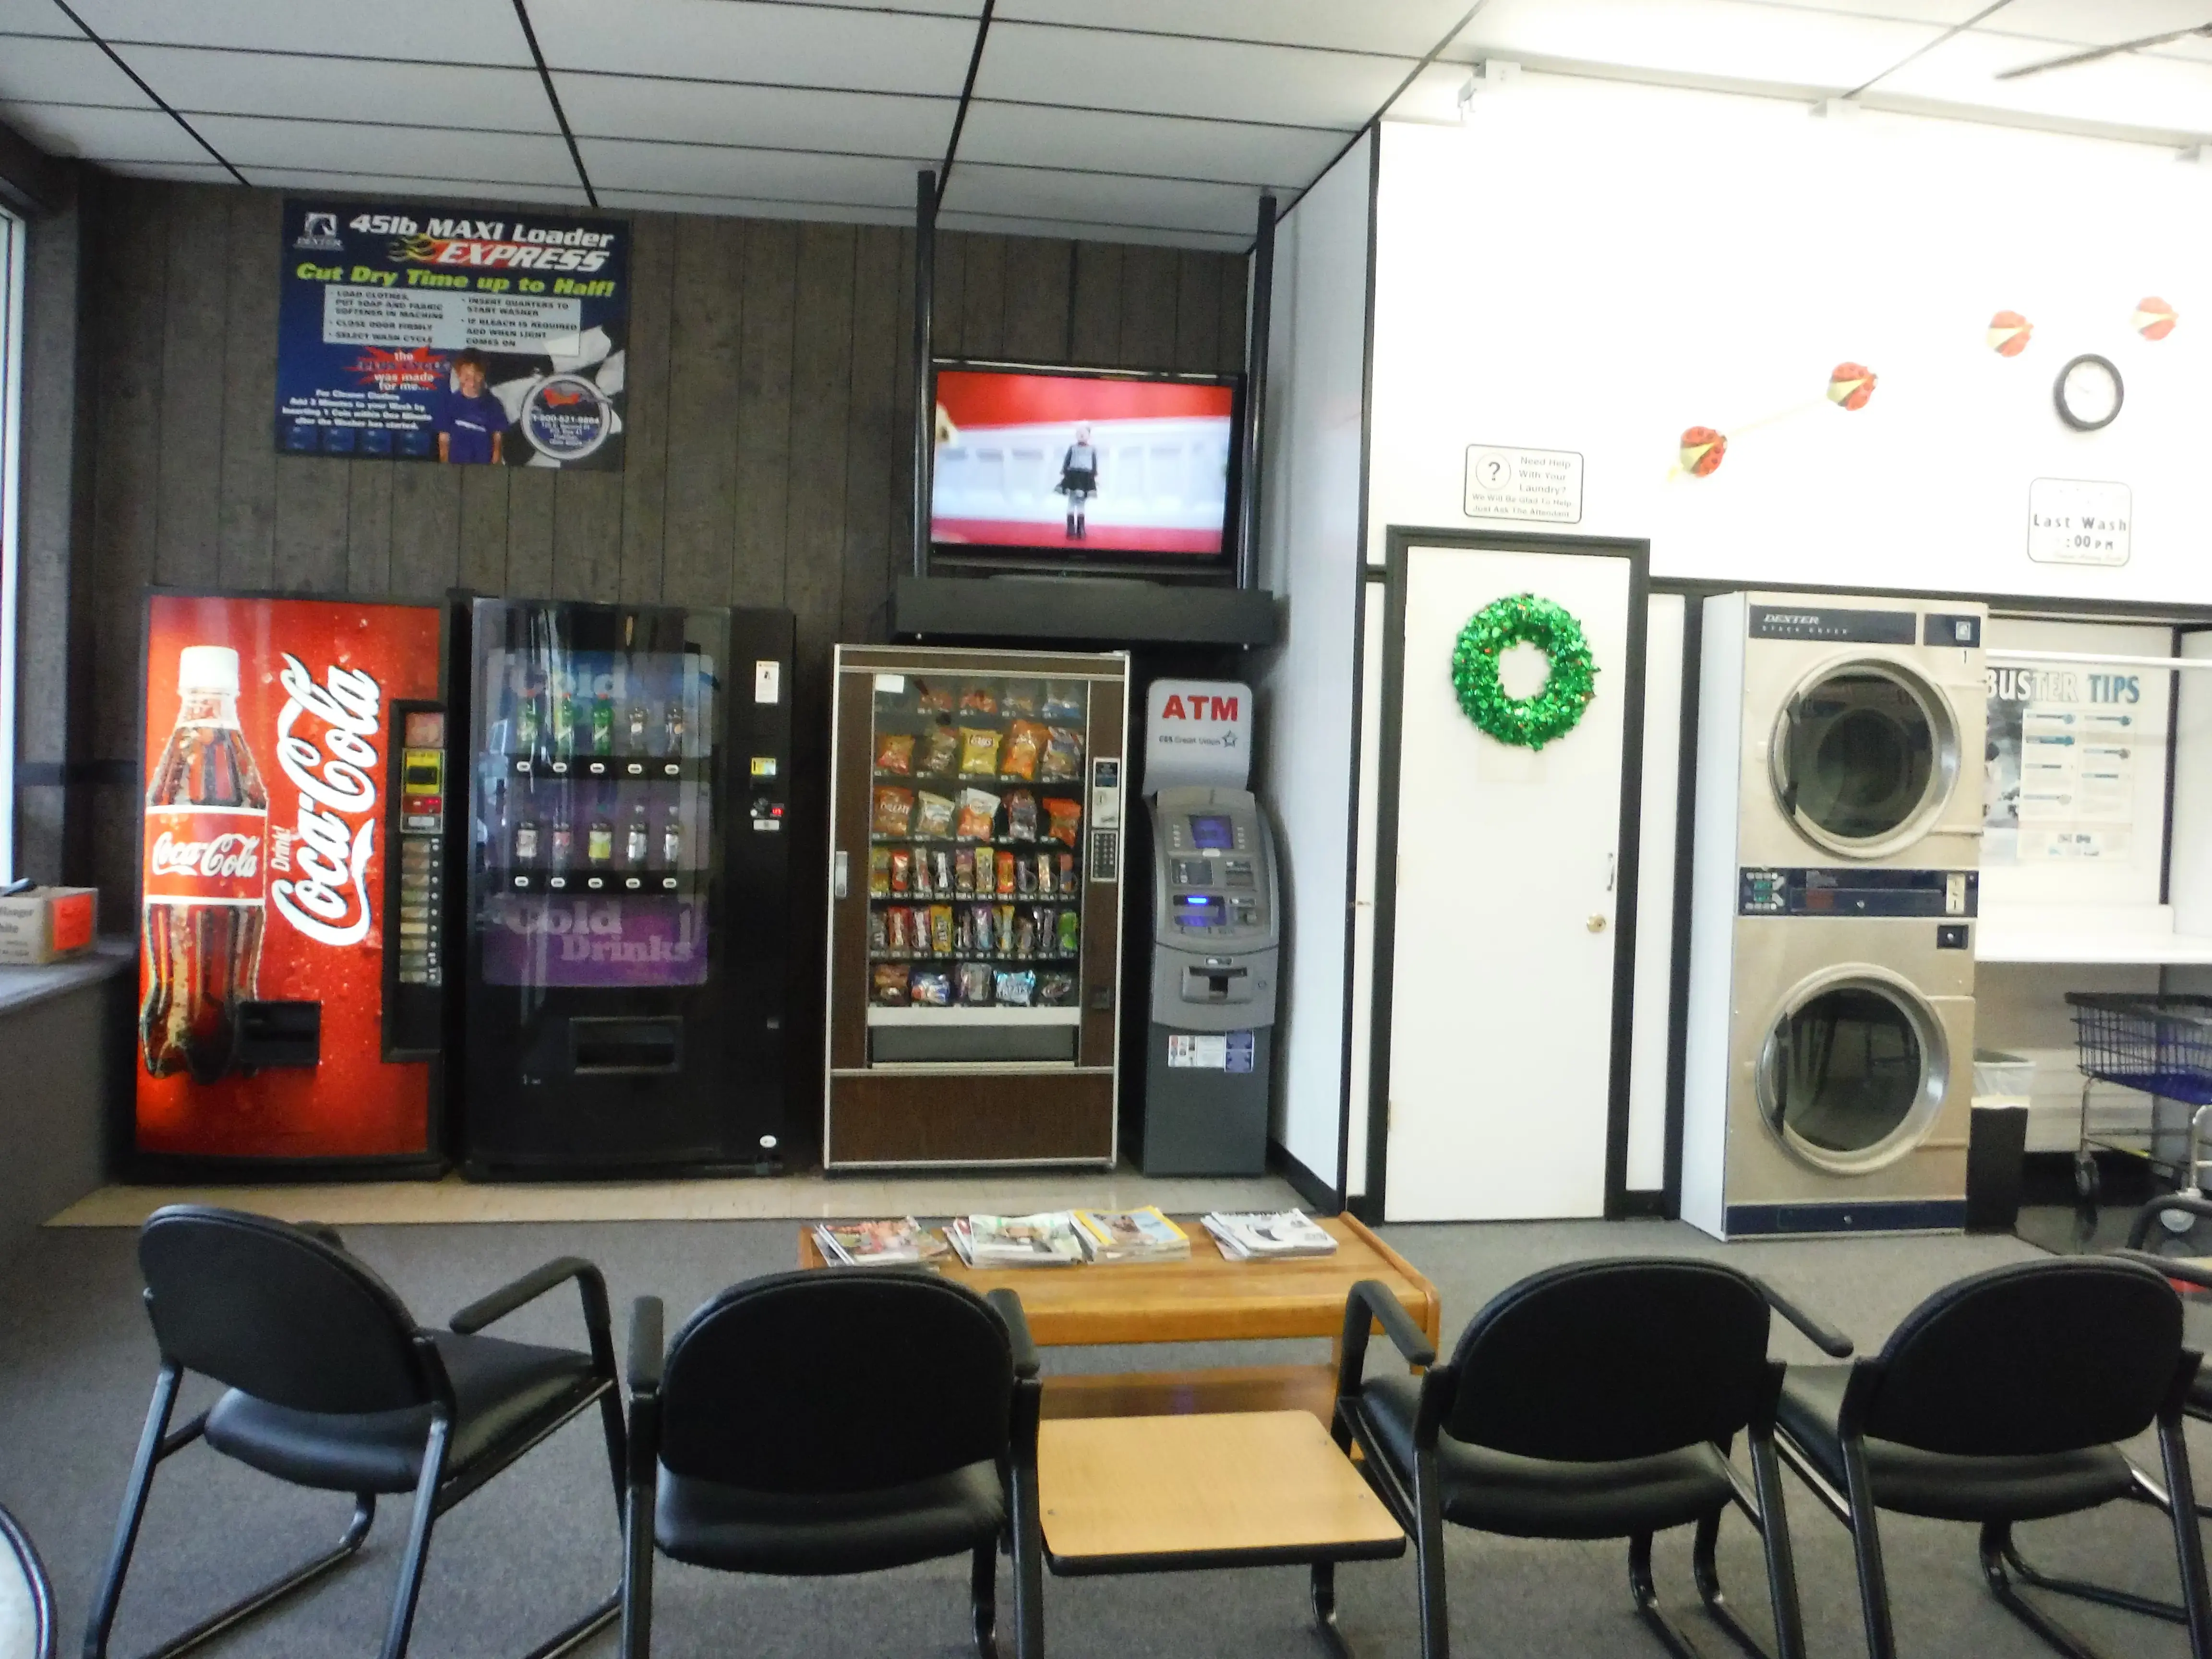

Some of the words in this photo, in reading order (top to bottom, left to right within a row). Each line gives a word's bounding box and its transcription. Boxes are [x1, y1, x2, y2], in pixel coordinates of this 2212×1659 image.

[349, 214, 417, 236] 45lb
[428, 218, 505, 240] MAXI
[512, 223, 615, 248] Loader
[437, 242, 610, 272] EXPRESS
[297, 263, 343, 281] Cut
[350, 265, 399, 287] Dry
[407, 268, 469, 289] Time
[477, 276, 510, 292] up
[518, 277, 545, 292] to
[553, 277, 616, 297] Half!
[480, 318, 516, 326] BLEACH
[466, 337, 499, 346] COMES
[394, 350, 413, 361] the
[374, 373, 397, 382] was
[401, 372, 434, 382] made
[378, 379, 397, 391] for
[1520, 456, 1546, 466] Need
[1549, 459, 1571, 470] Help
[1519, 469, 1541, 480] With
[1545, 472, 1566, 481] Your
[1519, 483, 1566, 496] Laundry?
[1472, 493, 1485, 501] We
[1487, 494, 1503, 503] Will
[1505, 495, 1516, 503] Be
[1519, 496, 1538, 505] Glad
[1541, 497, 1551, 505] To
[1553, 499, 1572, 508] Help
[1513, 506, 1527, 515] The
[1530, 507, 1570, 518] Attendant
[2033, 512, 2071, 529] Last
[2081, 516, 2127, 532] Wash
[1987, 668, 2080, 703] BUSTER
[2088, 674, 2140, 704] TIPS
[1162, 694, 1238, 722] ATM
[560, 934, 694, 962] Drinks
